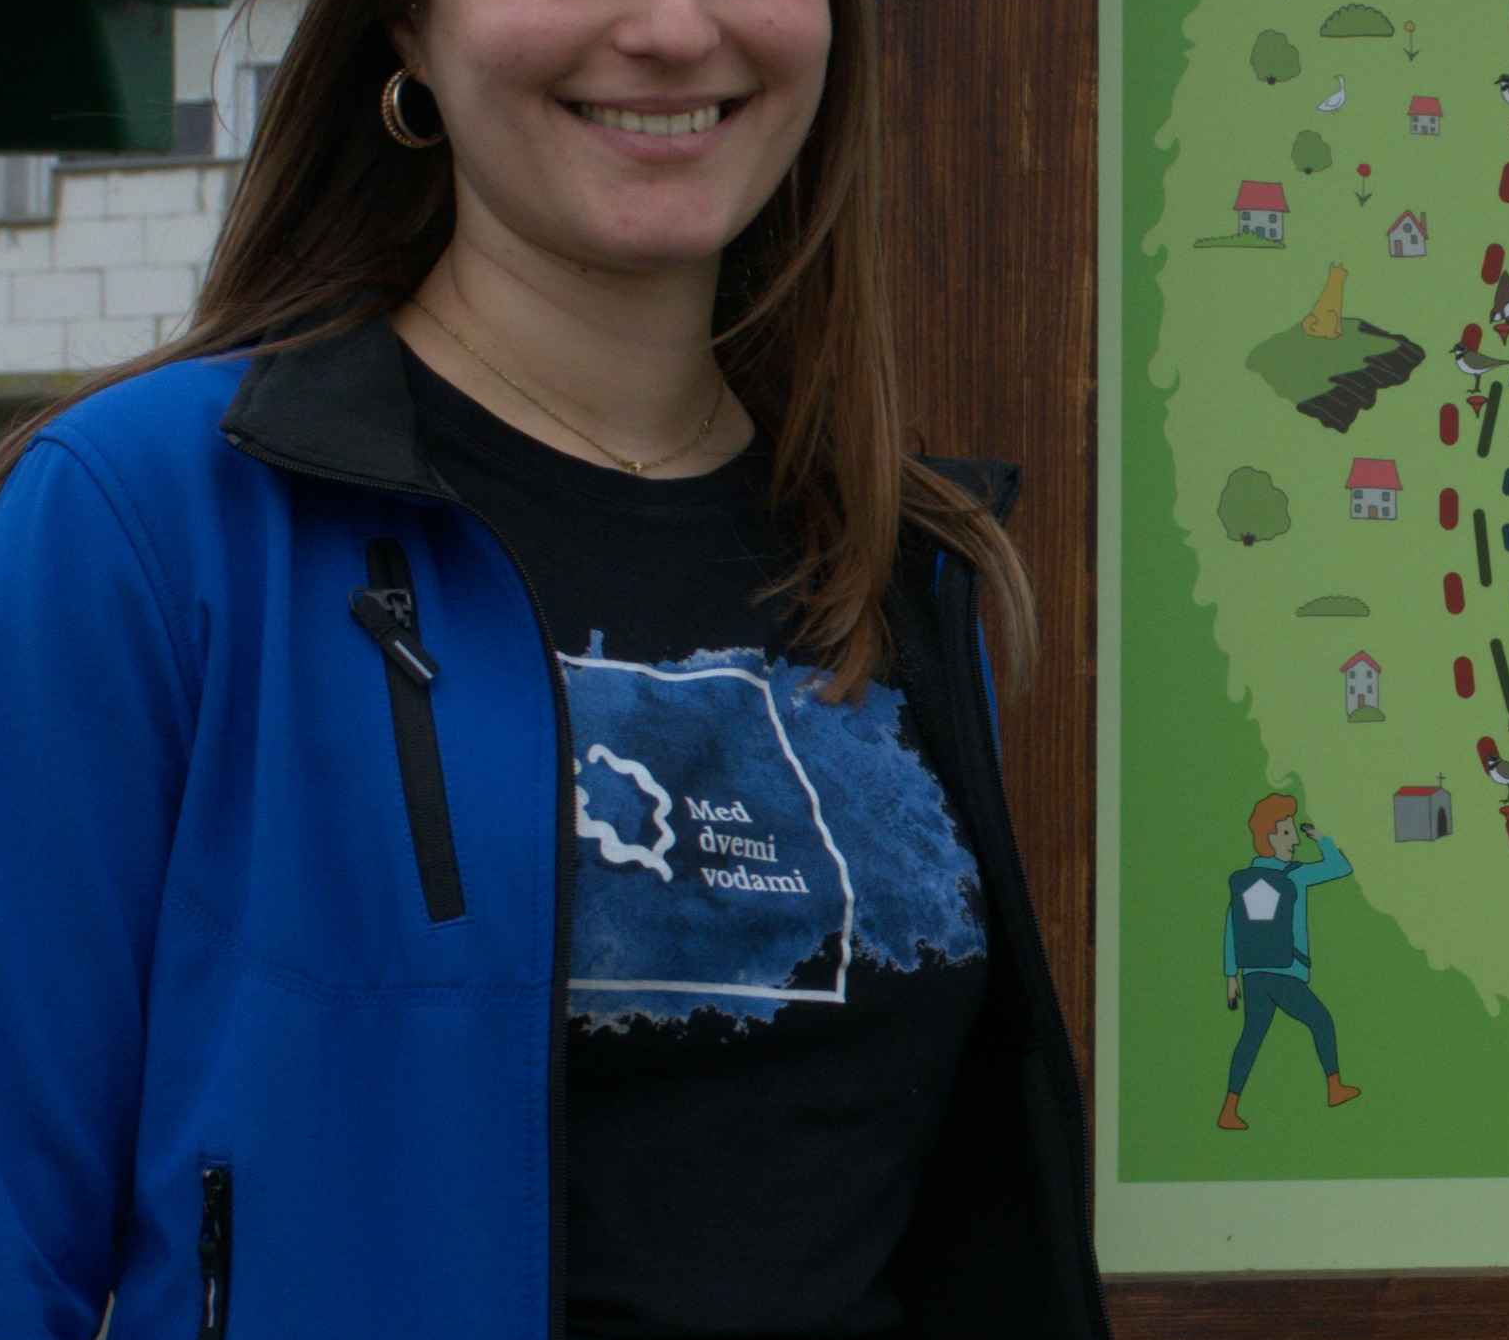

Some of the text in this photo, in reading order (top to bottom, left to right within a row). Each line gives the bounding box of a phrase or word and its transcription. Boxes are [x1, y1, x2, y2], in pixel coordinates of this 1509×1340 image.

[684, 795, 753, 823] Med
[698, 825, 779, 863] dvemi
[699, 864, 810, 894] vodami
